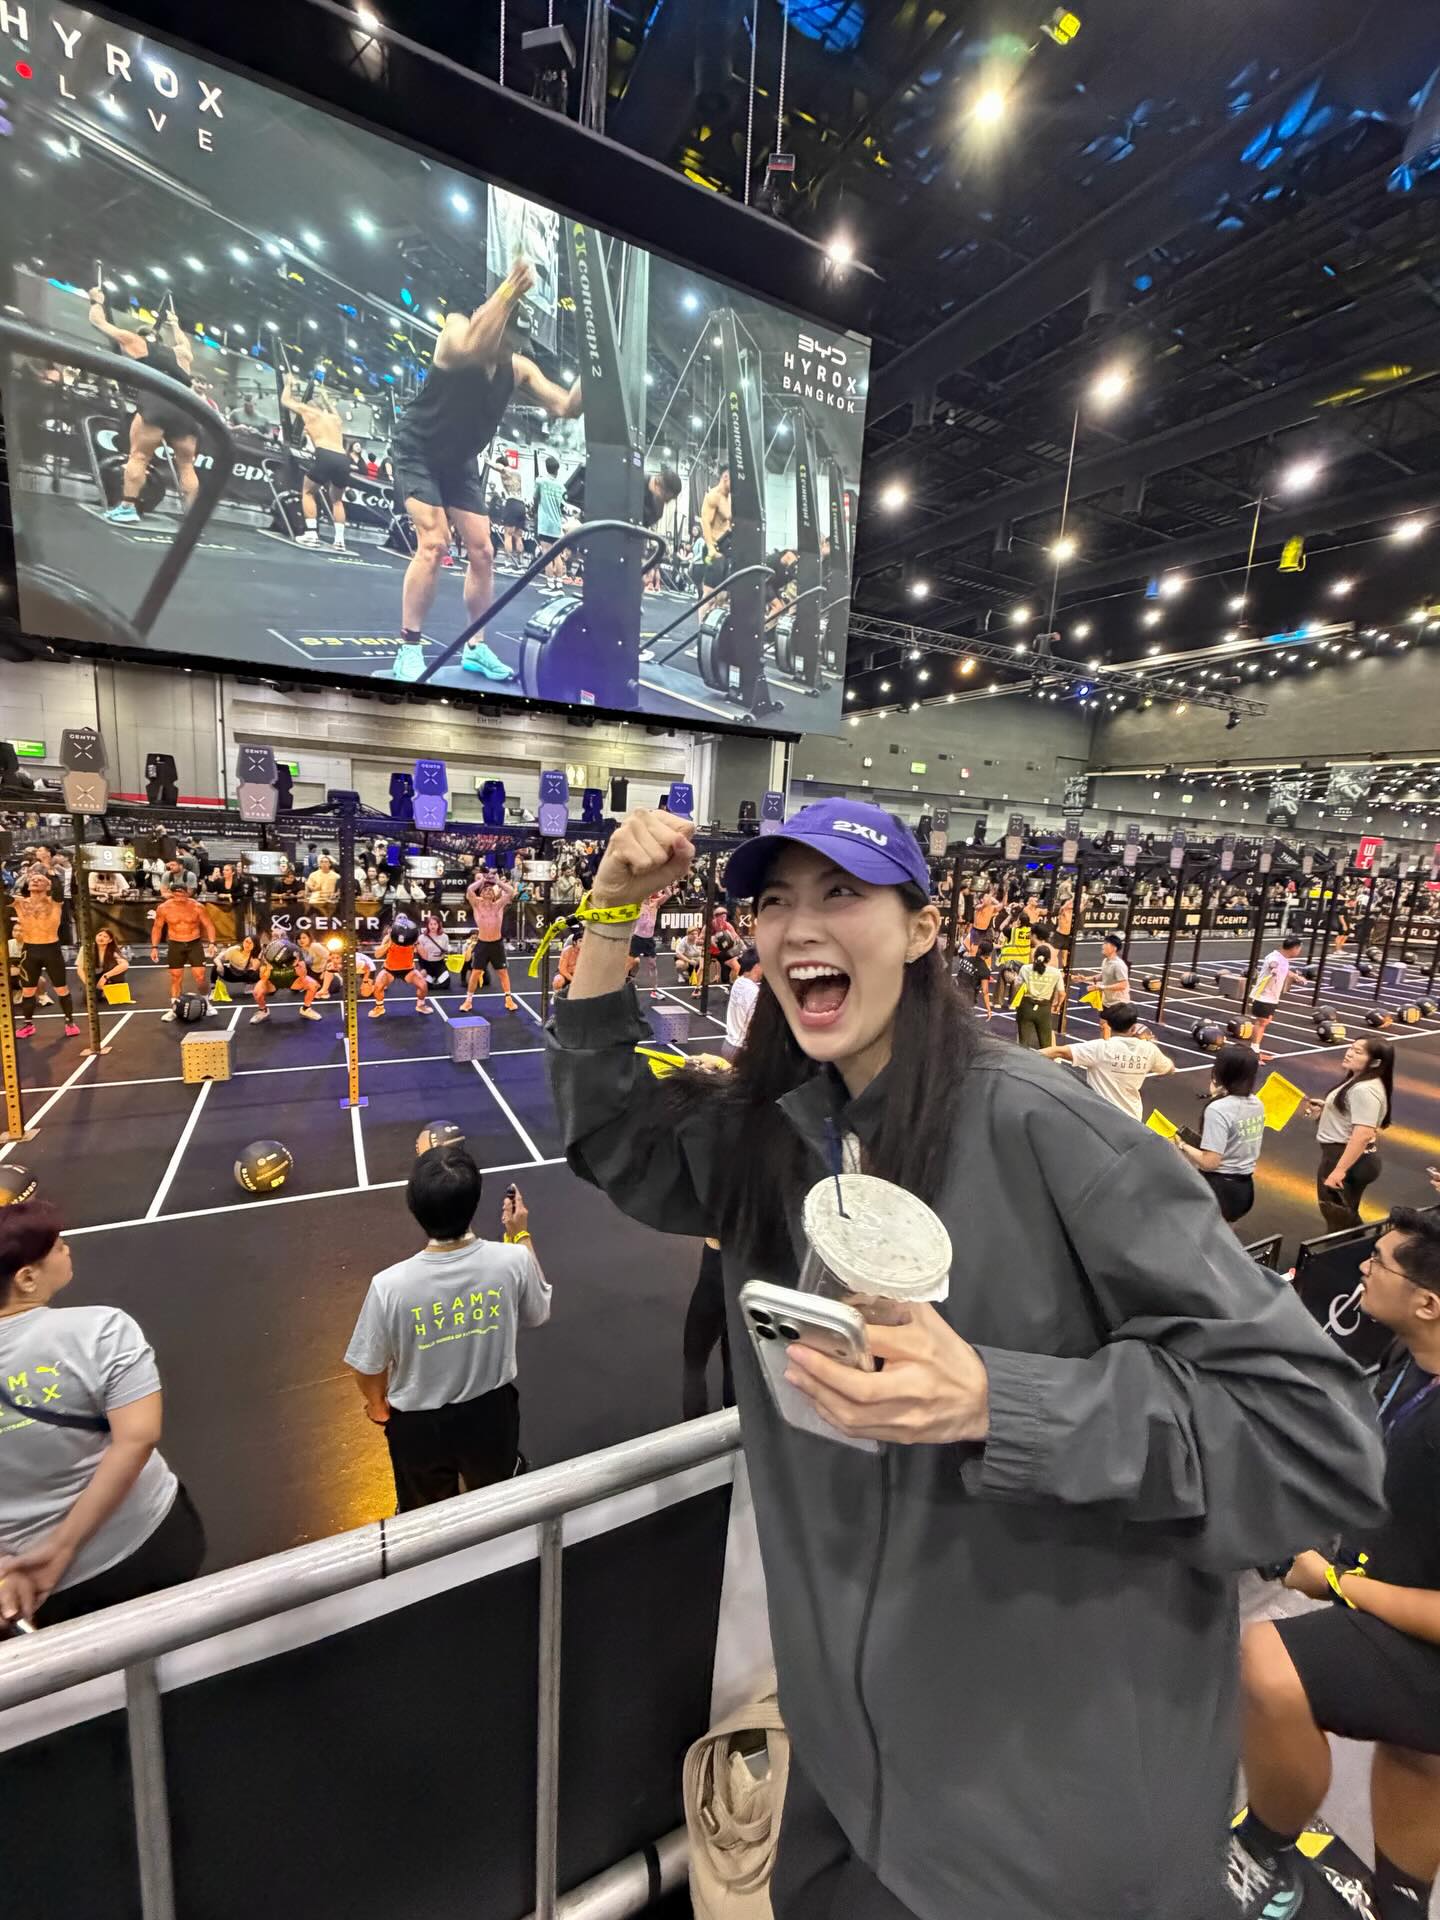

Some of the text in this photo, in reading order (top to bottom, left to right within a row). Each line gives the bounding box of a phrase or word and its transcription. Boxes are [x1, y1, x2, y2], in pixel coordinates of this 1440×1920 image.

[0, 0, 224, 118] HYROX
[578, 259, 602, 377] concept 2
[798, 334, 847, 366] BYD
[784, 352, 857, 394] HYROX
[783, 376, 855, 414] BANGKOK
[832, 820, 888, 847] 2XU
[296, 916, 380, 930] CENTR
[661, 912, 703, 929] PUMA
[1140, 915, 1170, 925] CENTR
[410, 1291, 483, 1321] TEAM
[414, 1304, 500, 1336] HYROX
